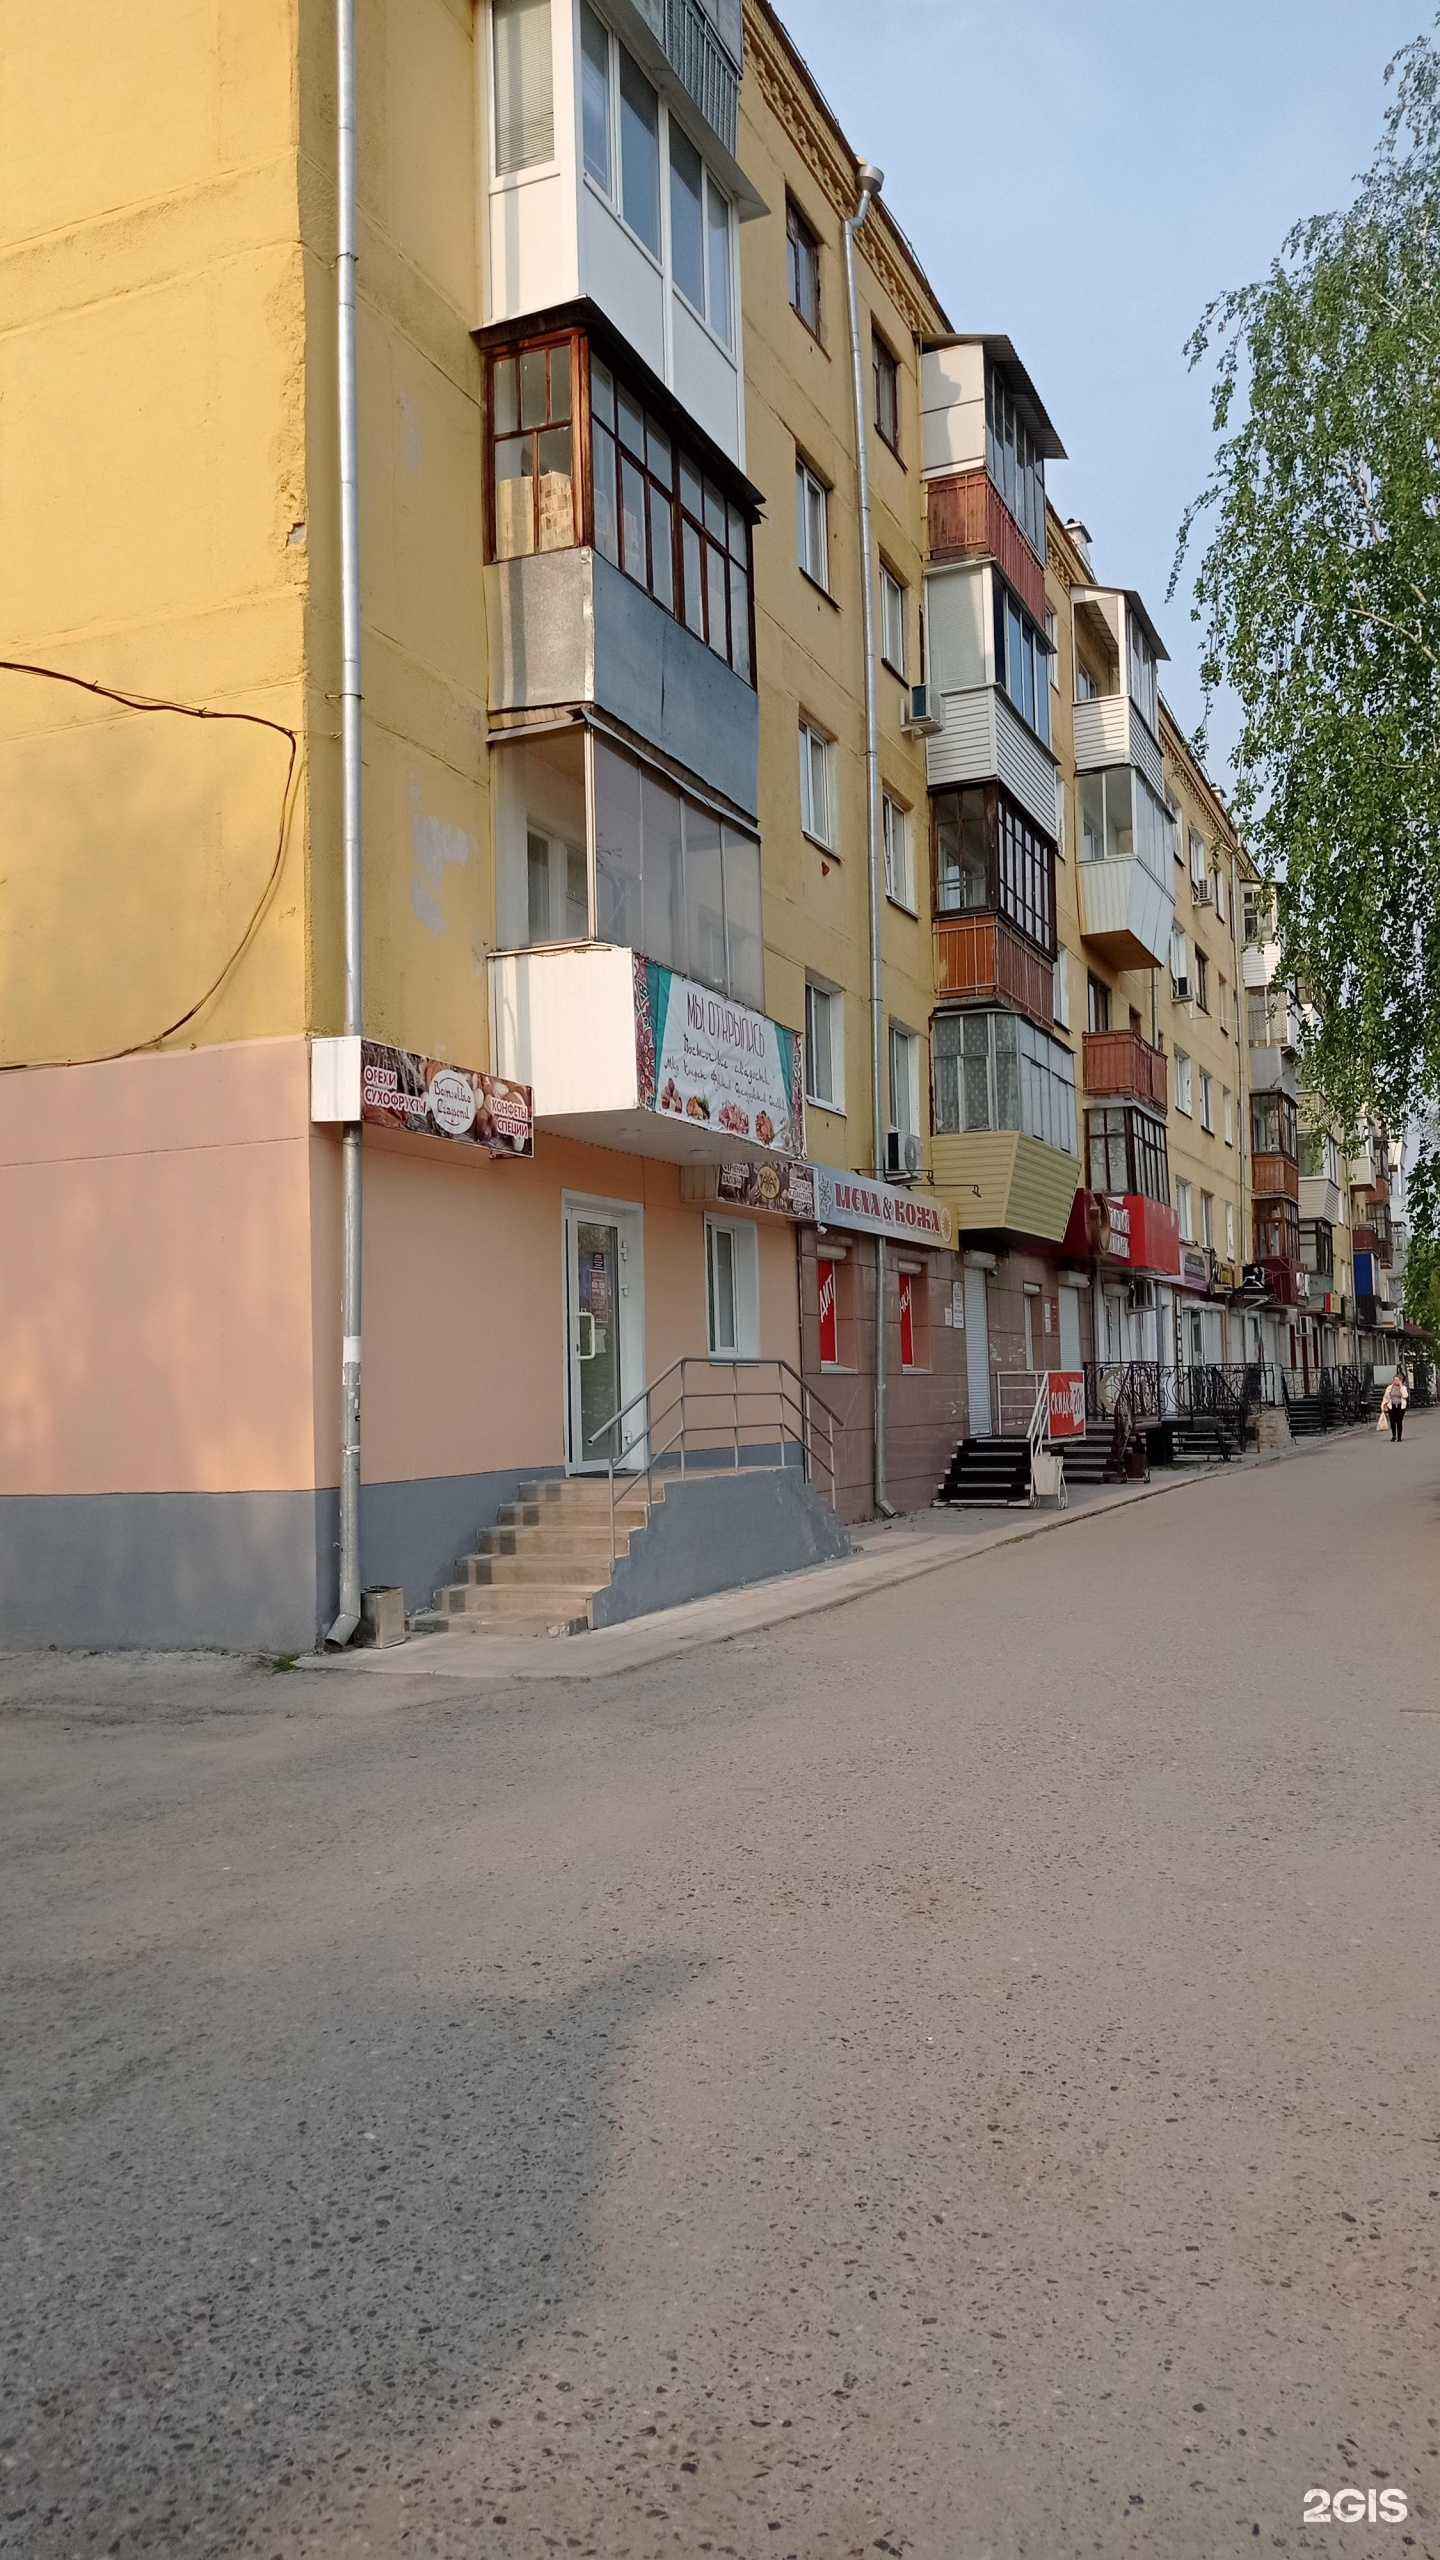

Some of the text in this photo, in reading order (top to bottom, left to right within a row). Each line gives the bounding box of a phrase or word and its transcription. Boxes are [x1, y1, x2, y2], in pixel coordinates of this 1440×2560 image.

[687, 992, 765, 1058] МЫ ОТКРЫЛИСЬ
[365, 1066, 396, 1088] ОРЕХИ
[365, 1087, 427, 1114] СУХОФРУКТЫ
[491, 1099, 528, 1120] КОНФЕТЫ
[497, 1119, 529, 1137] СПЕЦИИ
[835, 1183, 881, 1217] МЕХА
[883, 1196, 893, 1221] &
[895, 1199, 941, 1233] КОЖА
